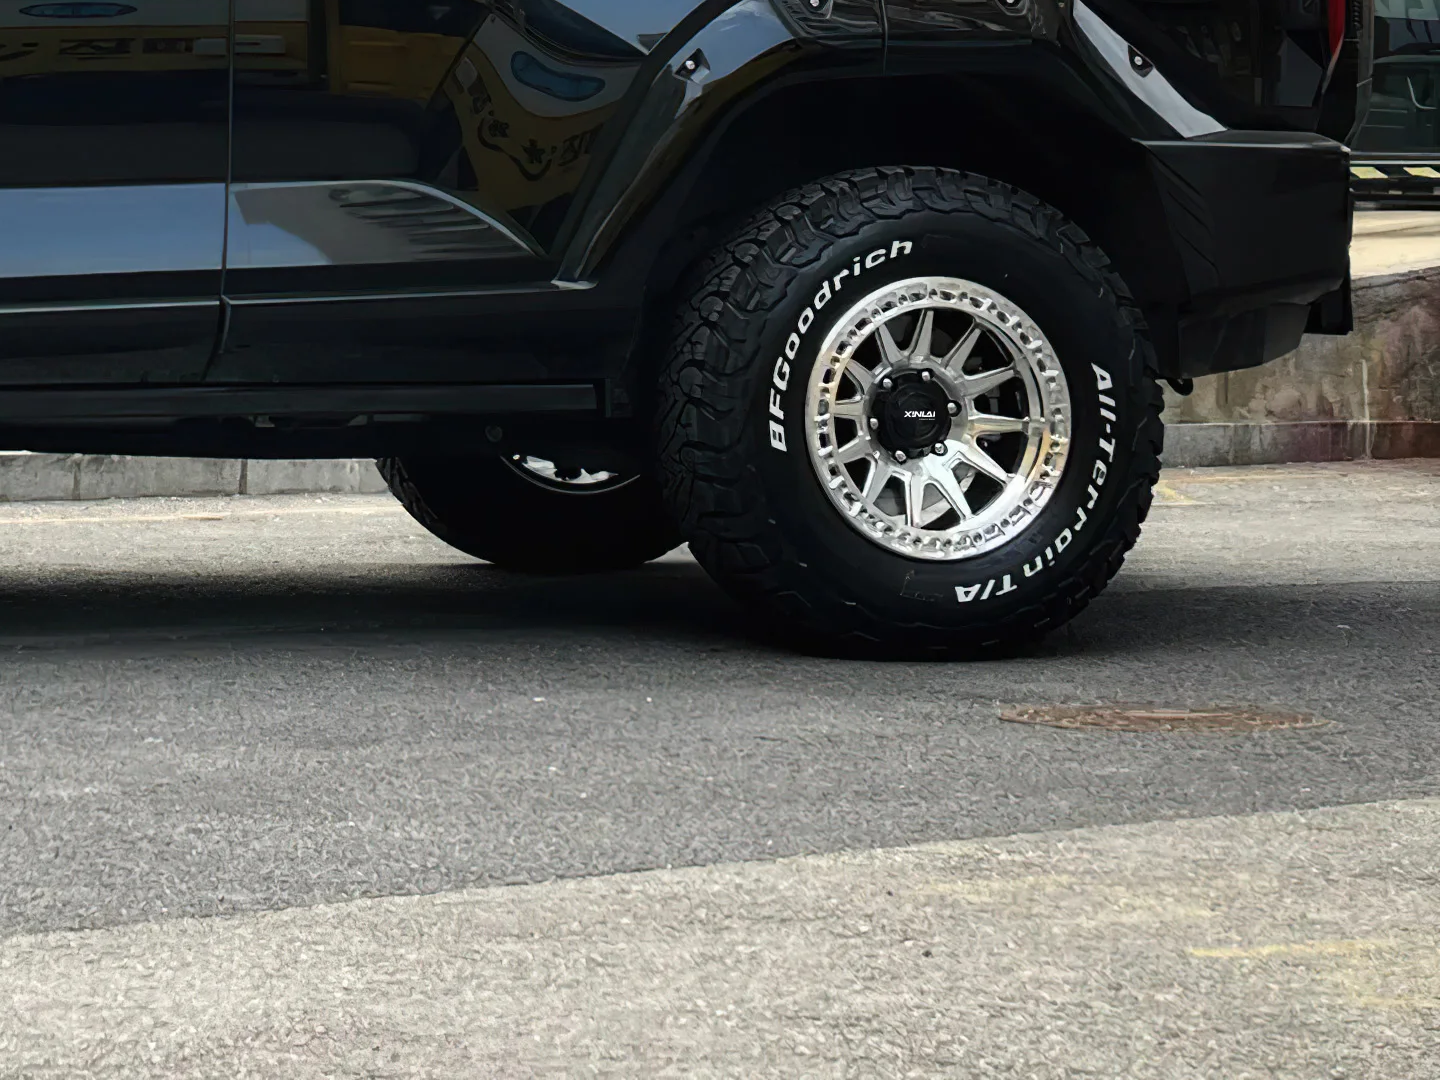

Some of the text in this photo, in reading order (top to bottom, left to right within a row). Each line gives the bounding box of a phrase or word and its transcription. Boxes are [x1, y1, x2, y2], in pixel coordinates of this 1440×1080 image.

[768, 240, 913, 452] BFGoodrich
[954, 363, 1117, 603] All-Terrain T/A
